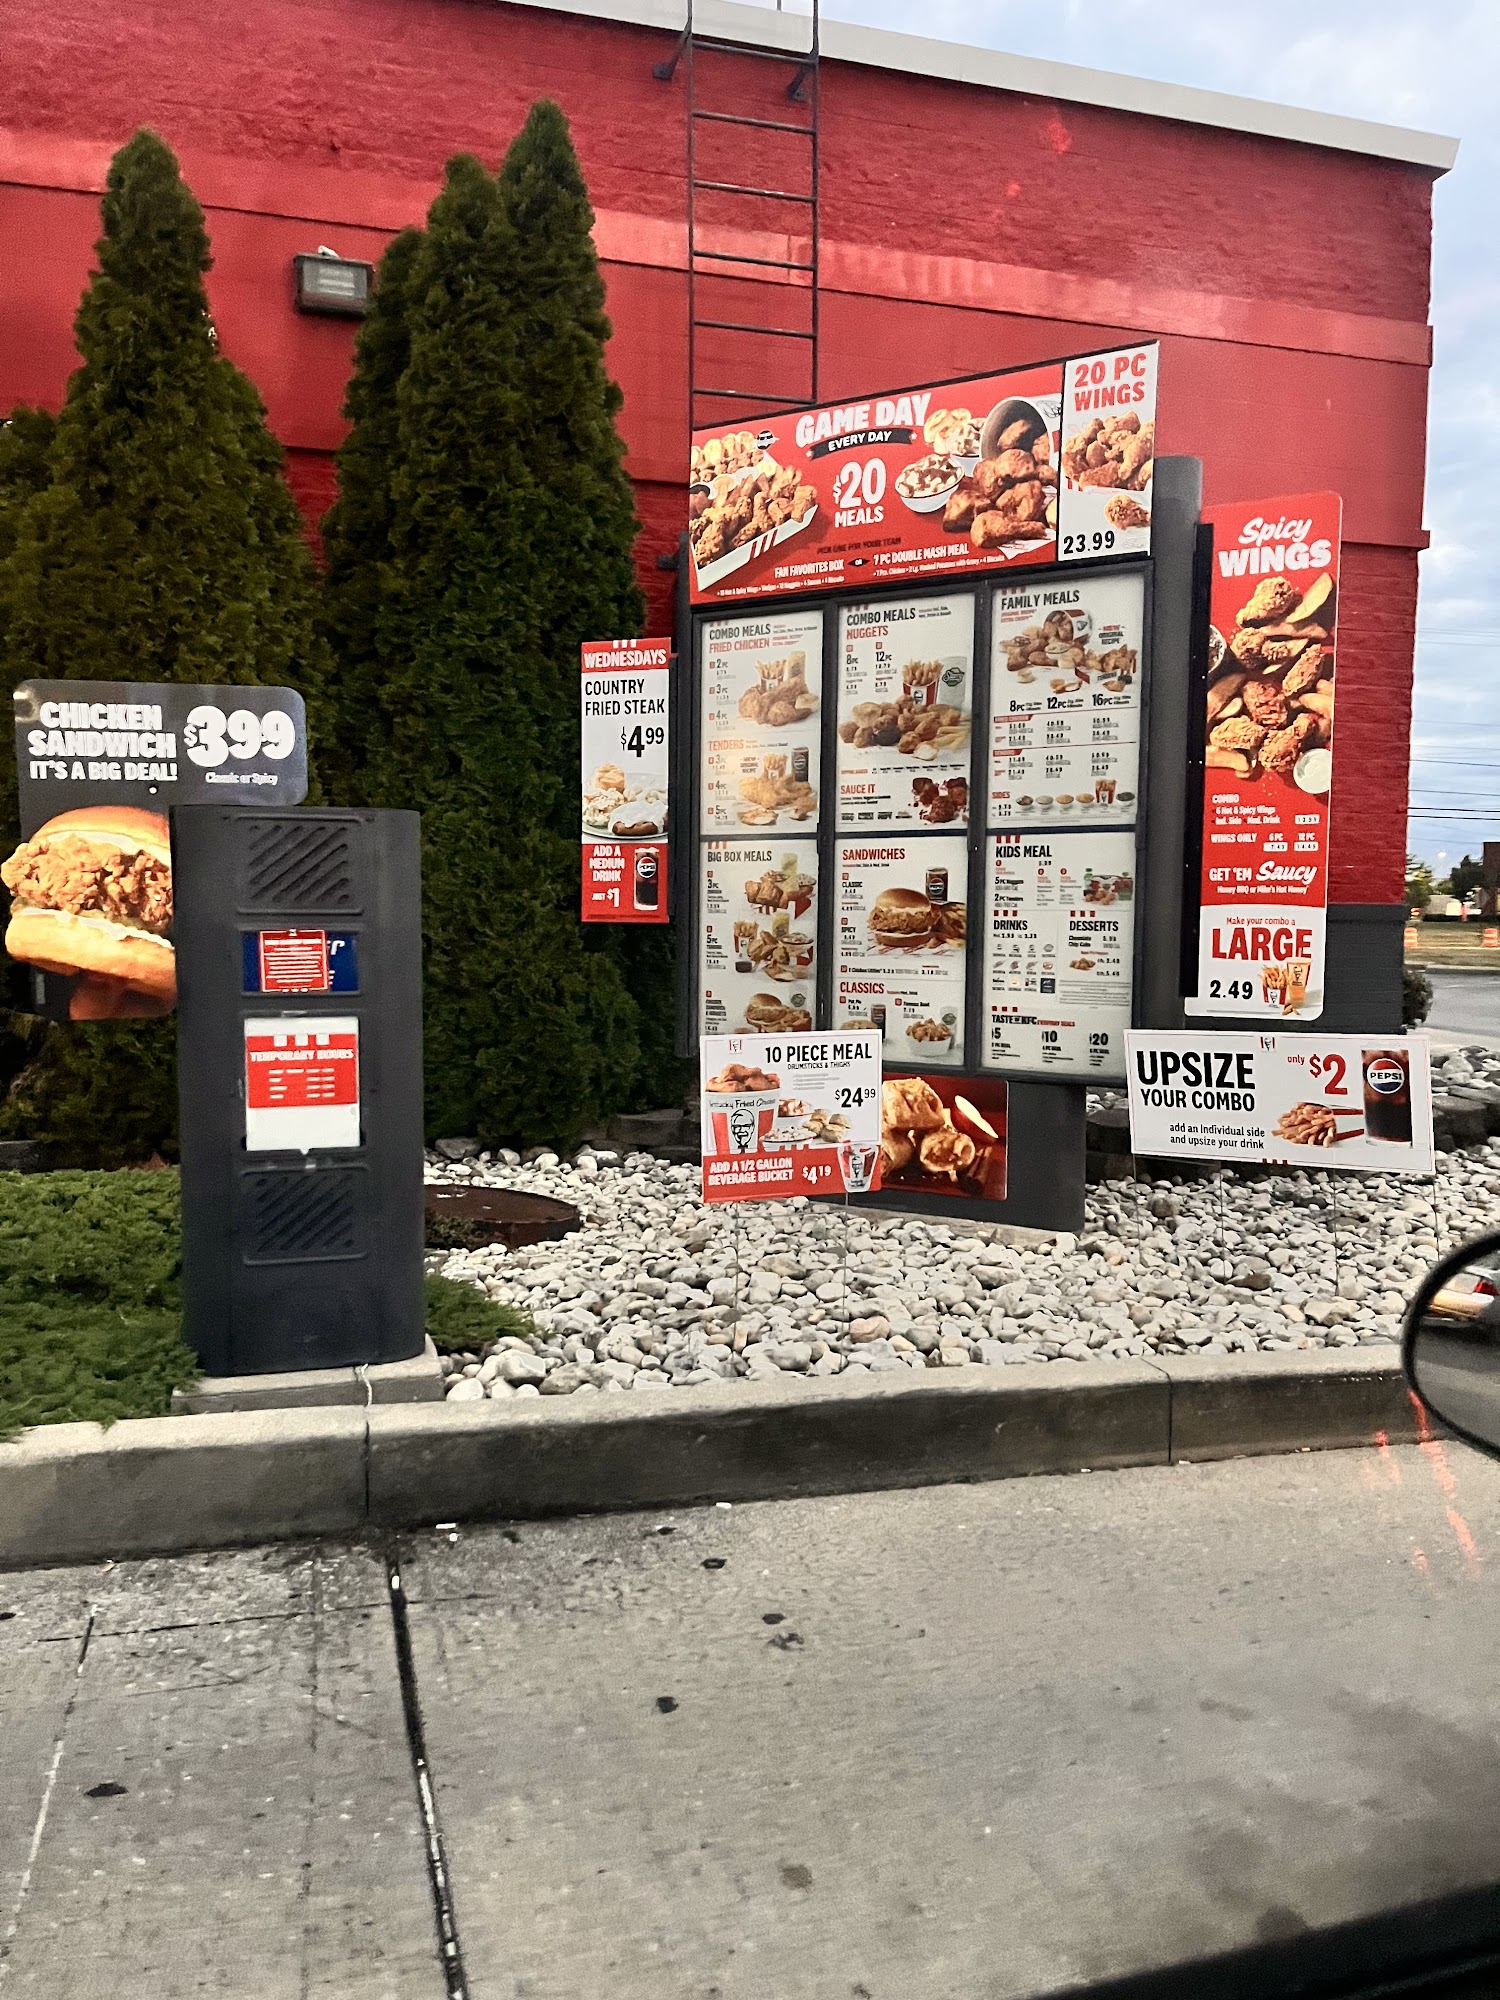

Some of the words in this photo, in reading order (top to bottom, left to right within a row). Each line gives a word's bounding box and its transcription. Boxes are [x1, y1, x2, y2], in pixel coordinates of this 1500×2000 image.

[1075, 360, 1106, 388] 20
[1114, 352, 1147, 381] PC
[1073, 381, 1145, 412] WINGS
[795, 404, 871, 448] GAME
[876, 392, 931, 427] DAY
[828, 432, 866, 452] EVERY
[868, 430, 893, 443] DAY
[832, 458, 887, 509] $20
[834, 506, 885, 528] MEALS
[1238, 516, 1313, 547] Spicy
[863, 539, 882, 550] YOUR
[883, 537, 902, 547] TEAM
[1063, 530, 1115, 555] 23.99
[873, 555, 879, 566] 7
[880, 553, 891, 565] PC
[891, 549, 923, 564] DOUBLE
[923, 546, 947, 560] MASH
[947, 543, 969, 557] MEAL
[1218, 539, 1332, 577] WINGS
[774, 566, 789, 579] FAN
[789, 561, 829, 577] FAVORITES
[828, 559, 845, 572] BOX
[1001, 594, 1041, 611] FAMILY
[1043, 589, 1080, 606] MEALS
[846, 611, 881, 626] COMBO
[883, 607, 916, 622] MEALS
[709, 626, 740, 640] COMBO
[742, 623, 771, 637] MEALS
[846, 625, 889, 640] NUGGETS
[709, 641, 732, 654] FRIED
[734, 638, 770, 651] CHICKEN
[1101, 637, 1120, 645] RECIPE
[584, 649, 667, 669] WEDNESDAYS
[585, 679, 645, 695] COUNTRY
[585, 700, 621, 716] FRIED
[624, 698, 665, 715] STEAK
[40, 701, 163, 731] CHICKEN
[27, 730, 177, 758] SANDWICH
[708, 739, 744, 751] TENDERS
[29, 760, 68, 780] IT'S
[71, 761, 86, 780] A
[88, 761, 122, 780] BIG
[124, 761, 178, 781] DEAL!
[205, 772, 240, 785] Classic
[252, 772, 278, 786] Spicy
[840, 784, 866, 794] SAUCE
[867, 783, 876, 793] IT
[1212, 794, 1240, 804] COMBO
[1215, 807, 1221, 815] 6
[1221, 807, 1233, 815] Hot
[1239, 806, 1256, 816] Spicy
[1256, 805, 1276, 815] Wings
[1228, 816, 1242, 825] Side
[1262, 815, 1280, 824] Drink
[1210, 833, 1236, 843] WINGS
[1237, 833, 1258, 843] ONLY
[1269, 833, 1275, 841] 6
[1275, 833, 1284, 841] PC
[1306, 833, 1316, 841] PC
[593, 845, 612, 856] ADD
[613, 845, 621, 856] A
[707, 851, 722, 862] BIG
[724, 850, 742, 862] BOX
[743, 850, 772, 861] MEALS
[842, 848, 906, 860] SANDWICHES
[995, 845, 1021, 858] KIDS
[1023, 845, 1053, 858] MEAL
[589, 857, 625, 870] MEDIUM
[592, 870, 621, 882] DRINK
[1209, 867, 1231, 882] GET
[1232, 867, 1253, 881] 'EM
[1256, 861, 1318, 885] Saucy
[592, 892, 606, 901] JUST
[607, 887, 620, 908] $1
[1217, 886, 1236, 895] Honey
[1236, 885, 1249, 894] BBQ
[1256, 885, 1275, 894] Mike's
[1275, 885, 1287, 894] Hot
[993, 920, 1028, 931] DRINKS
[1069, 920, 1119, 932] DESSERTS
[1226, 917, 1245, 925] Make
[1246, 918, 1263, 926] your
[1264, 917, 1289, 925] combo
[1212, 927, 1313, 961] LARGE
[840, 981, 885, 994] CLASSICS
[1209, 979, 1254, 1000] 2.49
[991, 1014, 1014, 1024] TASTE
[1021, 1016, 1038, 1025] KFC
[250, 1050, 315, 1062] TEMPORARY
[317, 1048, 355, 1060] HOURS
[765, 1047, 782, 1063] 10
[786, 1044, 828, 1062] PIECE
[833, 1043, 873, 1061] MEAL
[787, 1062, 824, 1070] DRUMSTICKS
[830, 1061, 851, 1069] THIGHS
[1136, 1050, 1256, 1090] UPSIZE
[1287, 1054, 1306, 1066] only
[1309, 1053, 1349, 1095] $2
[1370, 1071, 1403, 1081] PEPSI
[735, 1098, 755, 1109] Fried
[1140, 1089, 1188, 1109] YOUR
[1191, 1090, 1256, 1112] COMBO
[1169, 1122, 1186, 1133] add
[1188, 1124, 1199, 1133] an
[1246, 1126, 1266, 1137] side
[1170, 1135, 1187, 1146] and
[1188, 1136, 1217, 1149] upsize
[1218, 1138, 1239, 1149] your
[1240, 1138, 1265, 1150] drink
[709, 1162, 730, 1174] ADD
[731, 1161, 739, 1172] A
[739, 1160, 756, 1172] 1/2
[756, 1157, 793, 1171] GALLON
[708, 1171, 758, 1187] BEVERAGE
[759, 1168, 794, 1182] BUCKET
